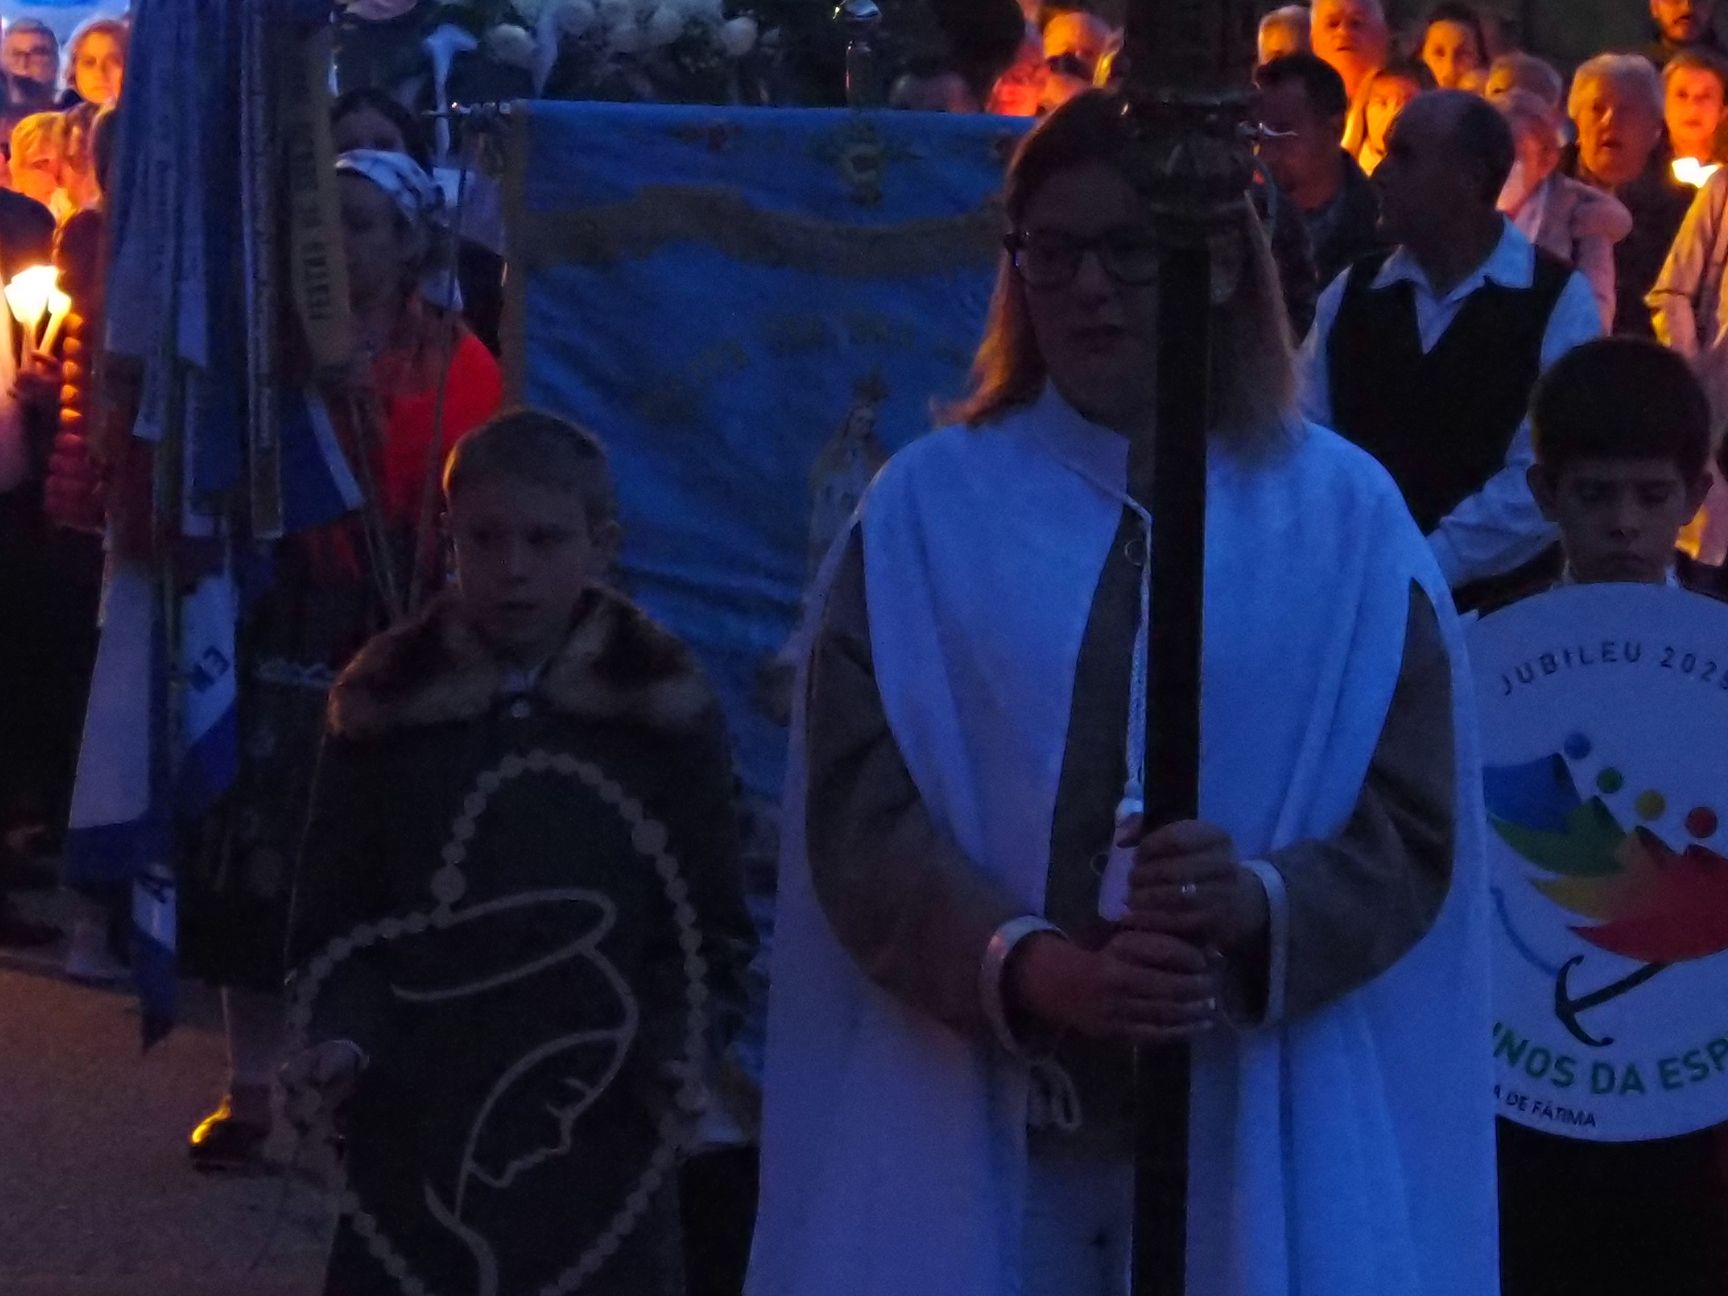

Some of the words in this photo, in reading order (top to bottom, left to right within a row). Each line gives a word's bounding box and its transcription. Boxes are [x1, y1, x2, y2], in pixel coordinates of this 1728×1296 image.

[1501, 640, 1642, 696] JUBILEU
[1590, 1060, 1646, 1095] DA
[1506, 1092, 1528, 1111] DE
